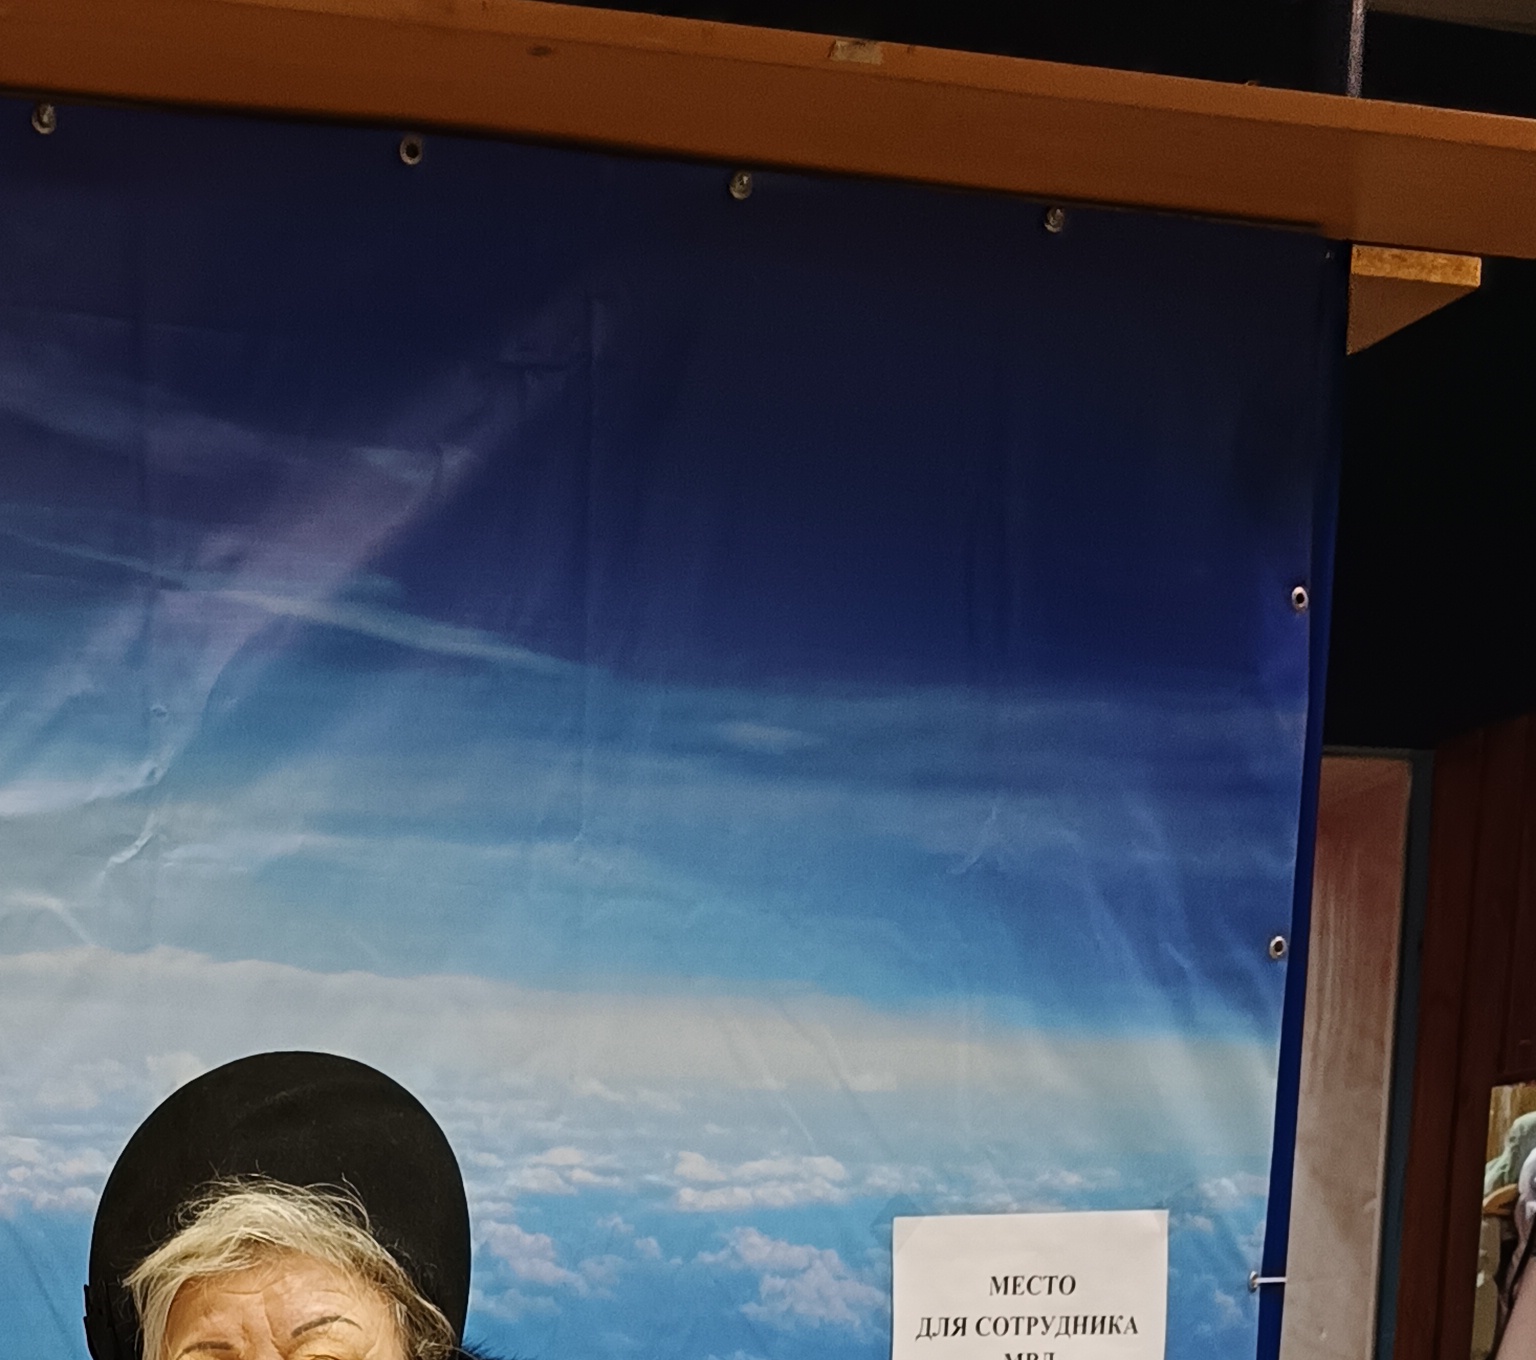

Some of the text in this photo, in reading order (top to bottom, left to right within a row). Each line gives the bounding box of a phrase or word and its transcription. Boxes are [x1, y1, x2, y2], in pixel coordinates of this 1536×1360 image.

[989, 1275, 1076, 1296] МЕСТО
[915, 1315, 1139, 1341] ДЛЯ СОТРУДНИКА
